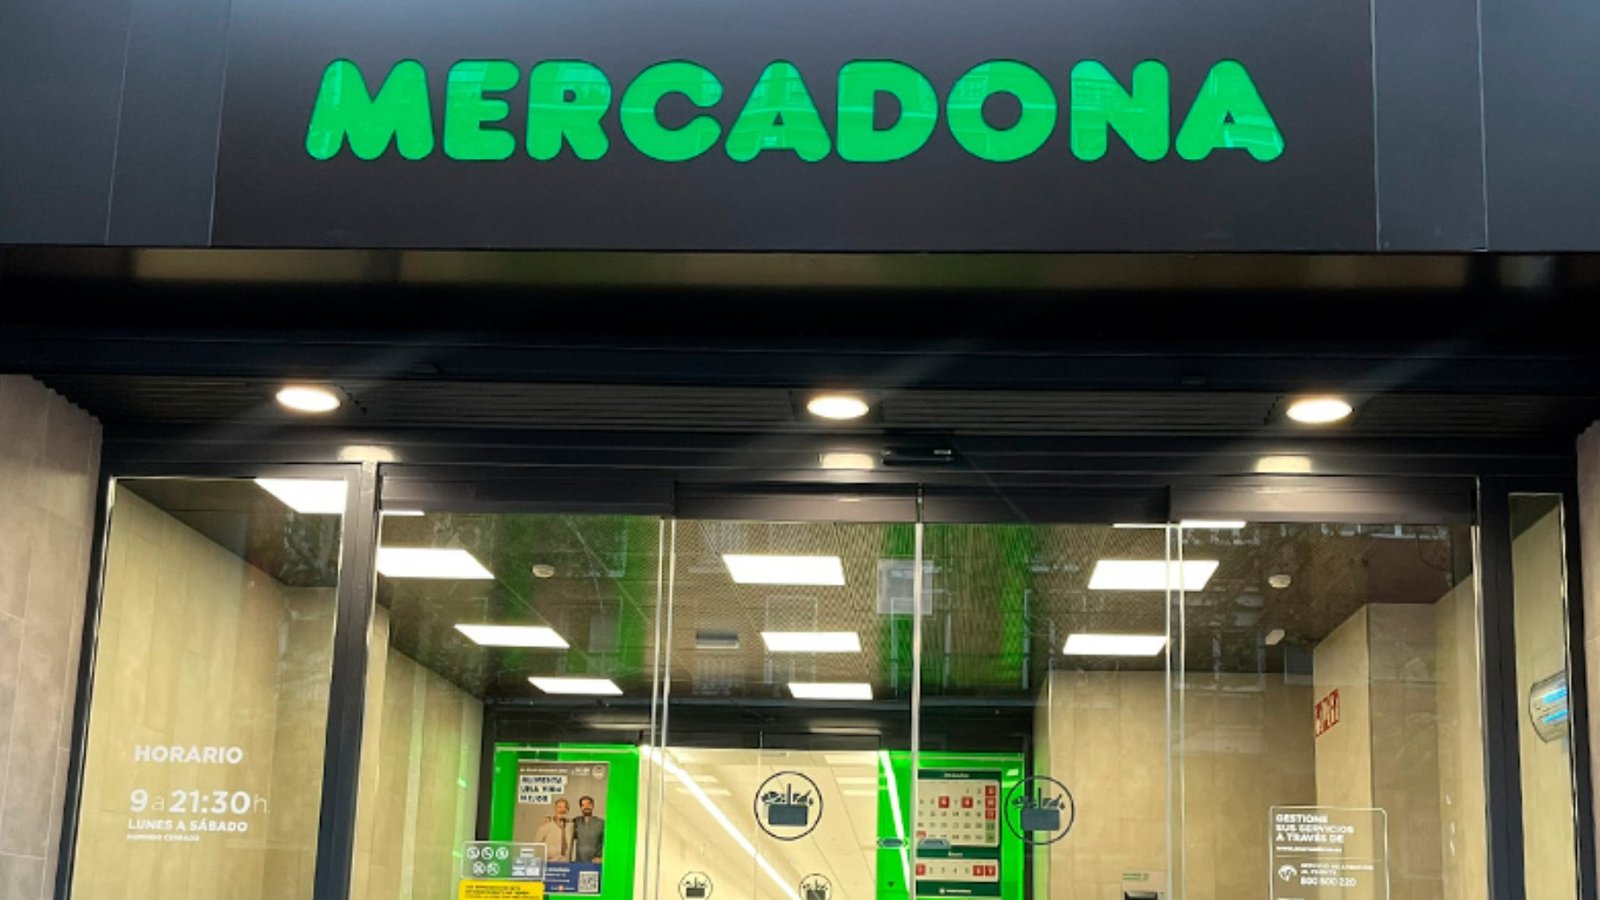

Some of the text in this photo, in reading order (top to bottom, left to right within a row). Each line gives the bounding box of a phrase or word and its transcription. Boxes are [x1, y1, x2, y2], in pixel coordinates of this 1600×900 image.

[305, 58, 1285, 162] MERCADONA
[133, 745, 244, 764] HORARIO
[129, 788, 148, 813] 9
[151, 796, 165, 812] a
[168, 789, 251, 815] 21:30
[127, 818, 249, 832] LUNES A SÁBADO
[1275, 813, 1328, 823] GESTIONE
[1275, 833, 1285, 842] A
